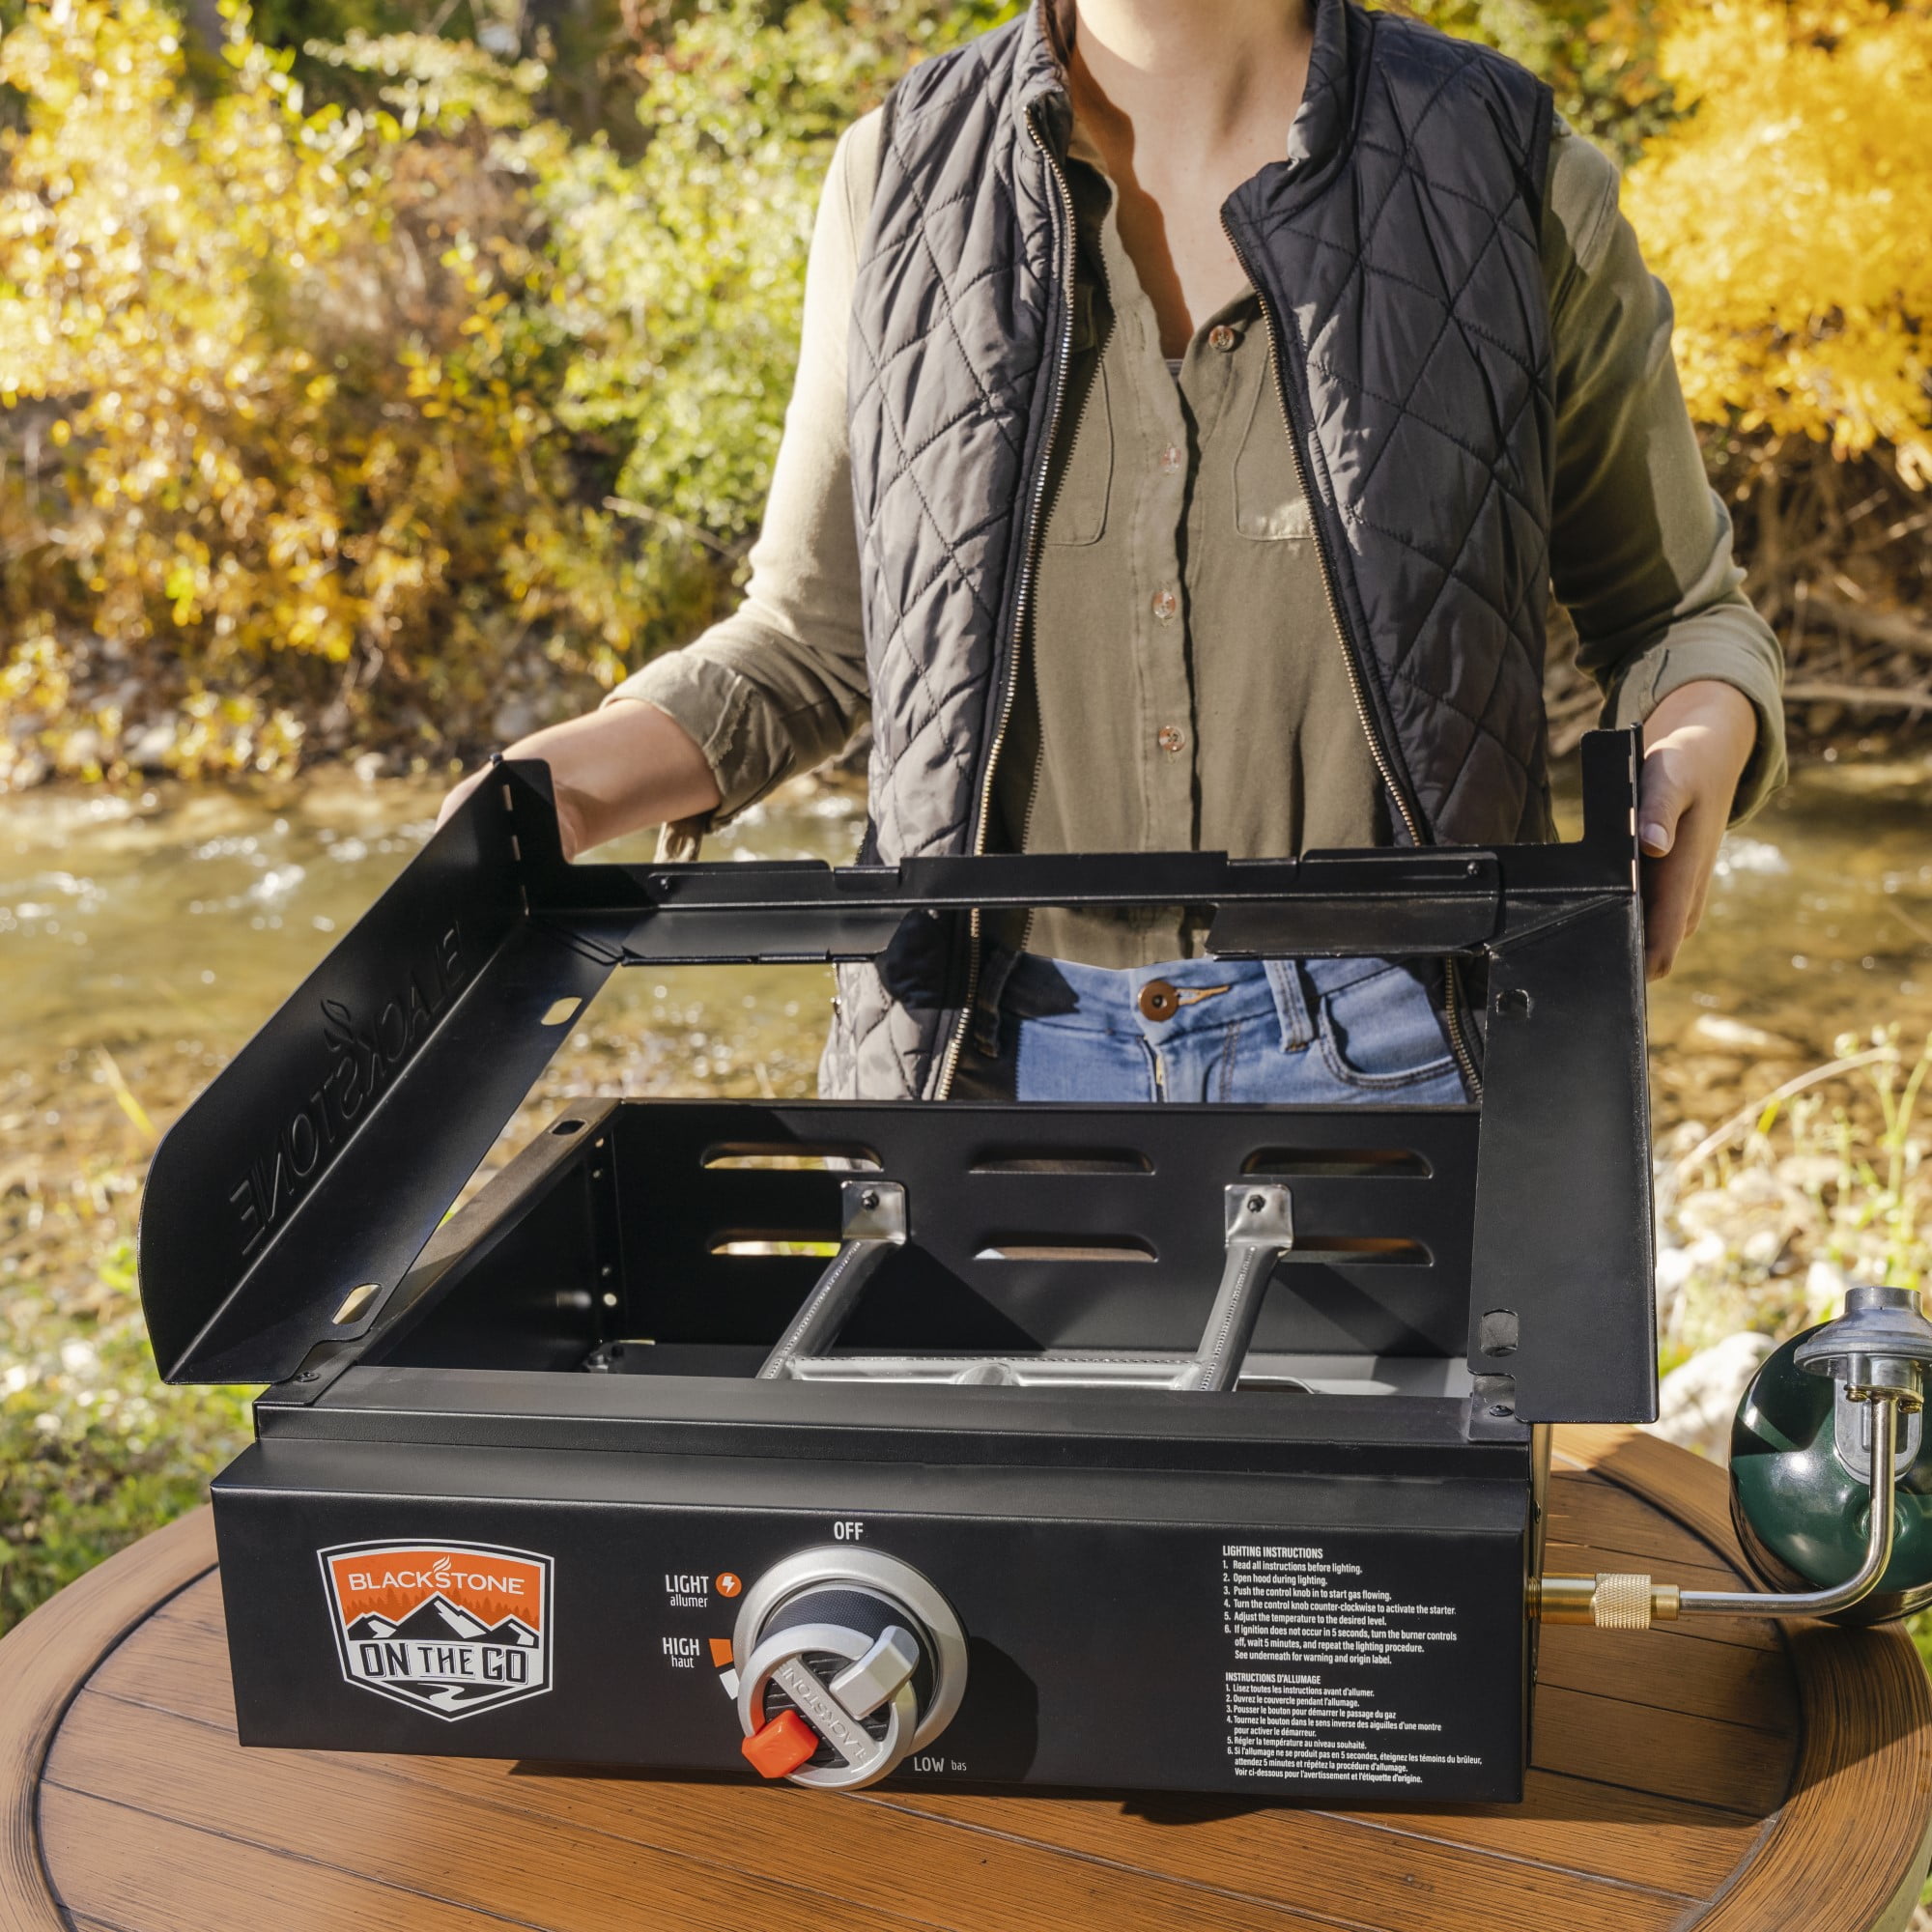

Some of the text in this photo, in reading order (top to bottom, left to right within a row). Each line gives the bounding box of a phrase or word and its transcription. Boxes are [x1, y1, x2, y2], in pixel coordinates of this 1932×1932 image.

[834, 1520, 864, 1541] OFF
[1222, 1546, 1323, 1558] LIGHTING INSTRUCTIONS
[1252, 1561, 1262, 1570] all
[1262, 1562, 1306, 1571] instructions
[1307, 1563, 1331, 1572] before
[348, 1570, 526, 1596] BLACKSTONE
[665, 1575, 709, 1594] LIGHT
[1233, 1574, 1252, 1584] Open
[1272, 1575, 1296, 1585] during
[669, 1594, 708, 1607] allumer
[1233, 1586, 1252, 1595] Push
[1252, 1587, 1265, 1596] the
[1265, 1588, 1292, 1597] control
[1293, 1588, 1311, 1597] knob
[1312, 1589, 1320, 1598] in
[1320, 1589, 1328, 1598] to
[1329, 1590, 1348, 1599] start
[1348, 1592, 1361, 1601] gas
[1250, 1600, 1264, 1608] the
[1264, 1601, 1291, 1609] control
[1310, 1602, 1377, 1612] counter-clockwise
[1385, 1605, 1415, 1613] activate
[1234, 1612, 1258, 1623] Adjust
[1271, 1613, 1317, 1625] temperature
[1325, 1615, 1338, 1624] the
[1339, 1616, 1366, 1625] desired
[1234, 1625, 1240, 1634] If
[1240, 1626, 1269, 1636] ignition
[1289, 1627, 1301, 1635] not
[1371, 1630, 1387, 1638] turn
[1401, 1631, 1426, 1639] burner
[1426, 1632, 1457, 1640] controls
[663, 1637, 700, 1656] HIGH
[1247, 1638, 1264, 1647] wait
[1318, 1641, 1342, 1652] repeat
[1355, 1642, 1384, 1653] lighting
[359, 1642, 529, 1685] ON THE GO
[671, 1655, 695, 1668] haut
[1249, 1652, 1291, 1661] underneath
[1303, 1653, 1333, 1663] warning
[1334, 1654, 1349, 1662] and
[1349, 1655, 1372, 1665] origin
[1225, 1673, 1321, 1684] INSTRUCTIONS D'ALLUMAGE
[914, 1756, 967, 1773] LOW bas
